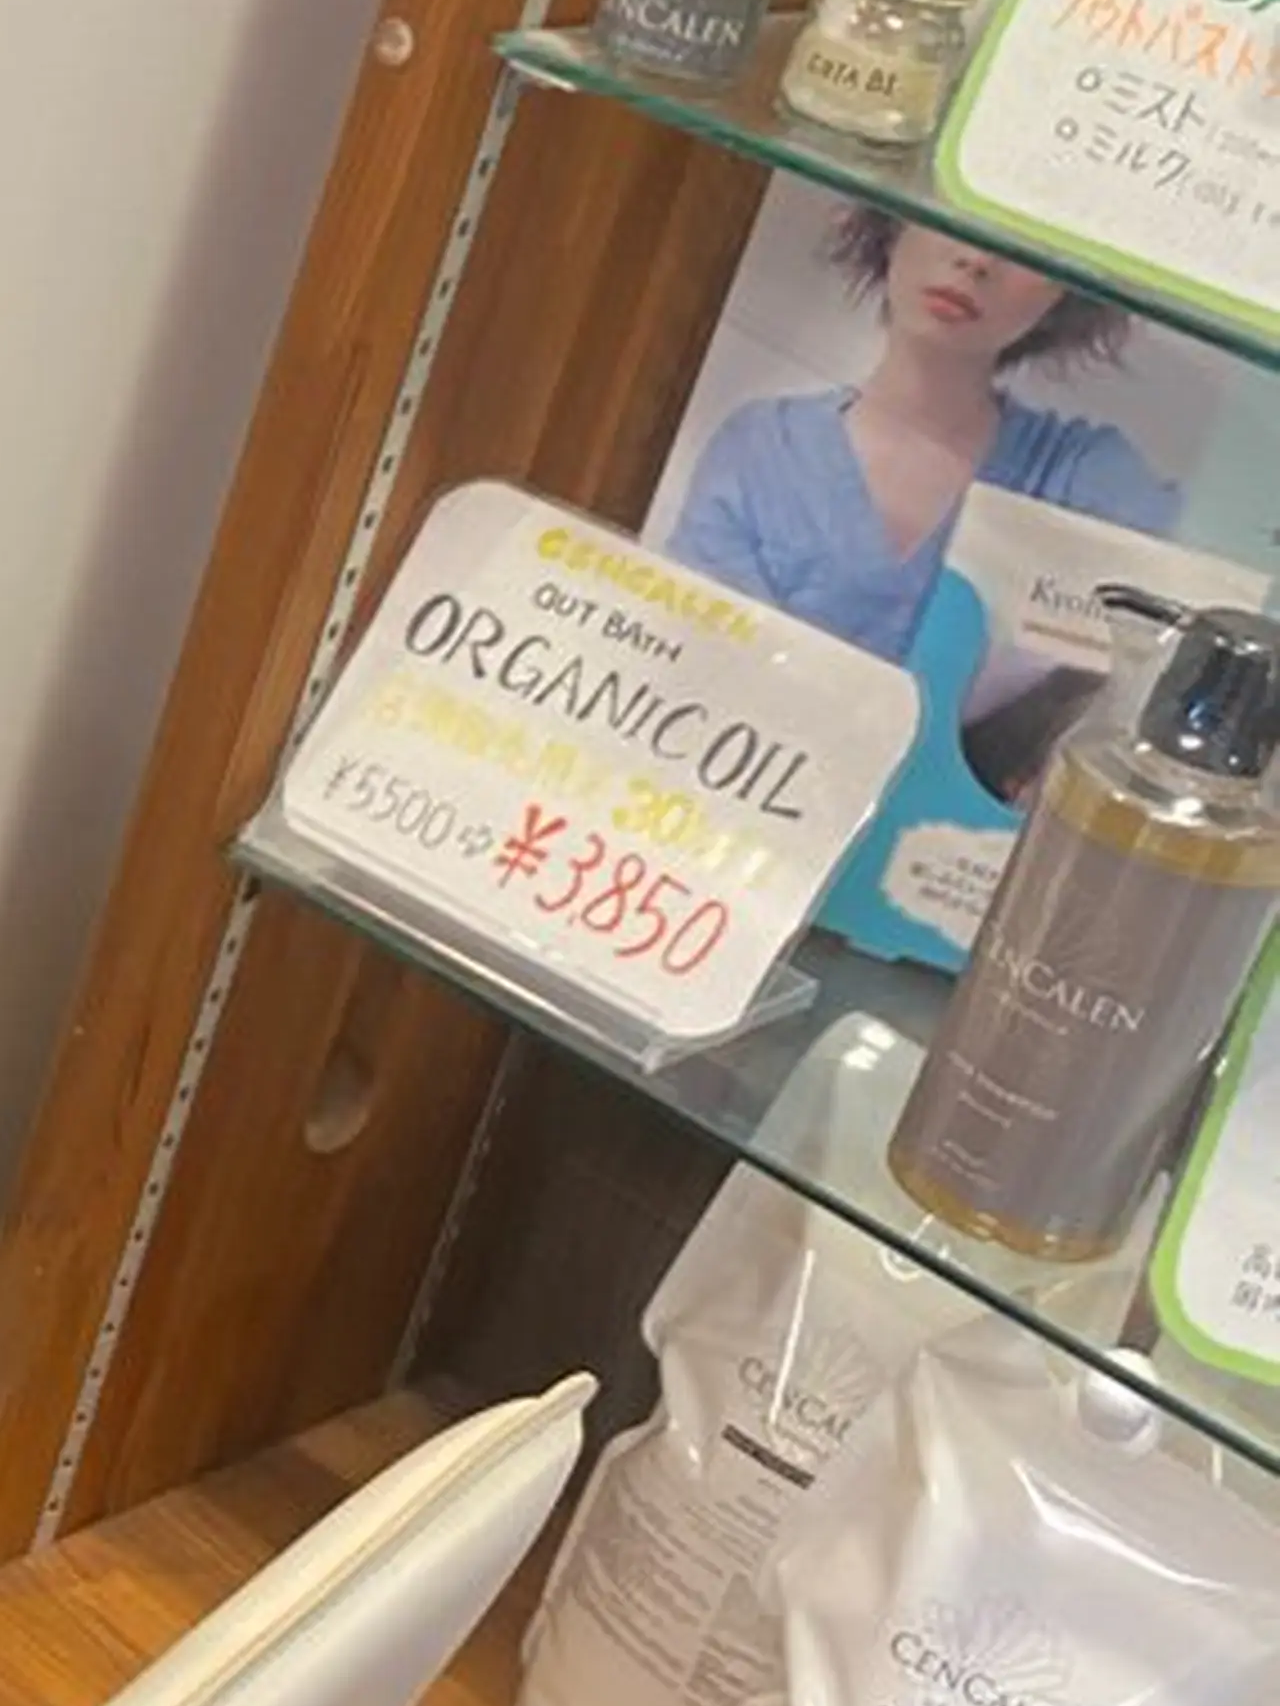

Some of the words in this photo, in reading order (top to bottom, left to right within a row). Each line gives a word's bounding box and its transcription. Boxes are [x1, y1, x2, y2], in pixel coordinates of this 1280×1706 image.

[531, 581, 600, 627] OUT
[601, 607, 684, 663] BATH
[404, 592, 710, 762] ORGANIC
[696, 721, 815, 821] OIL
